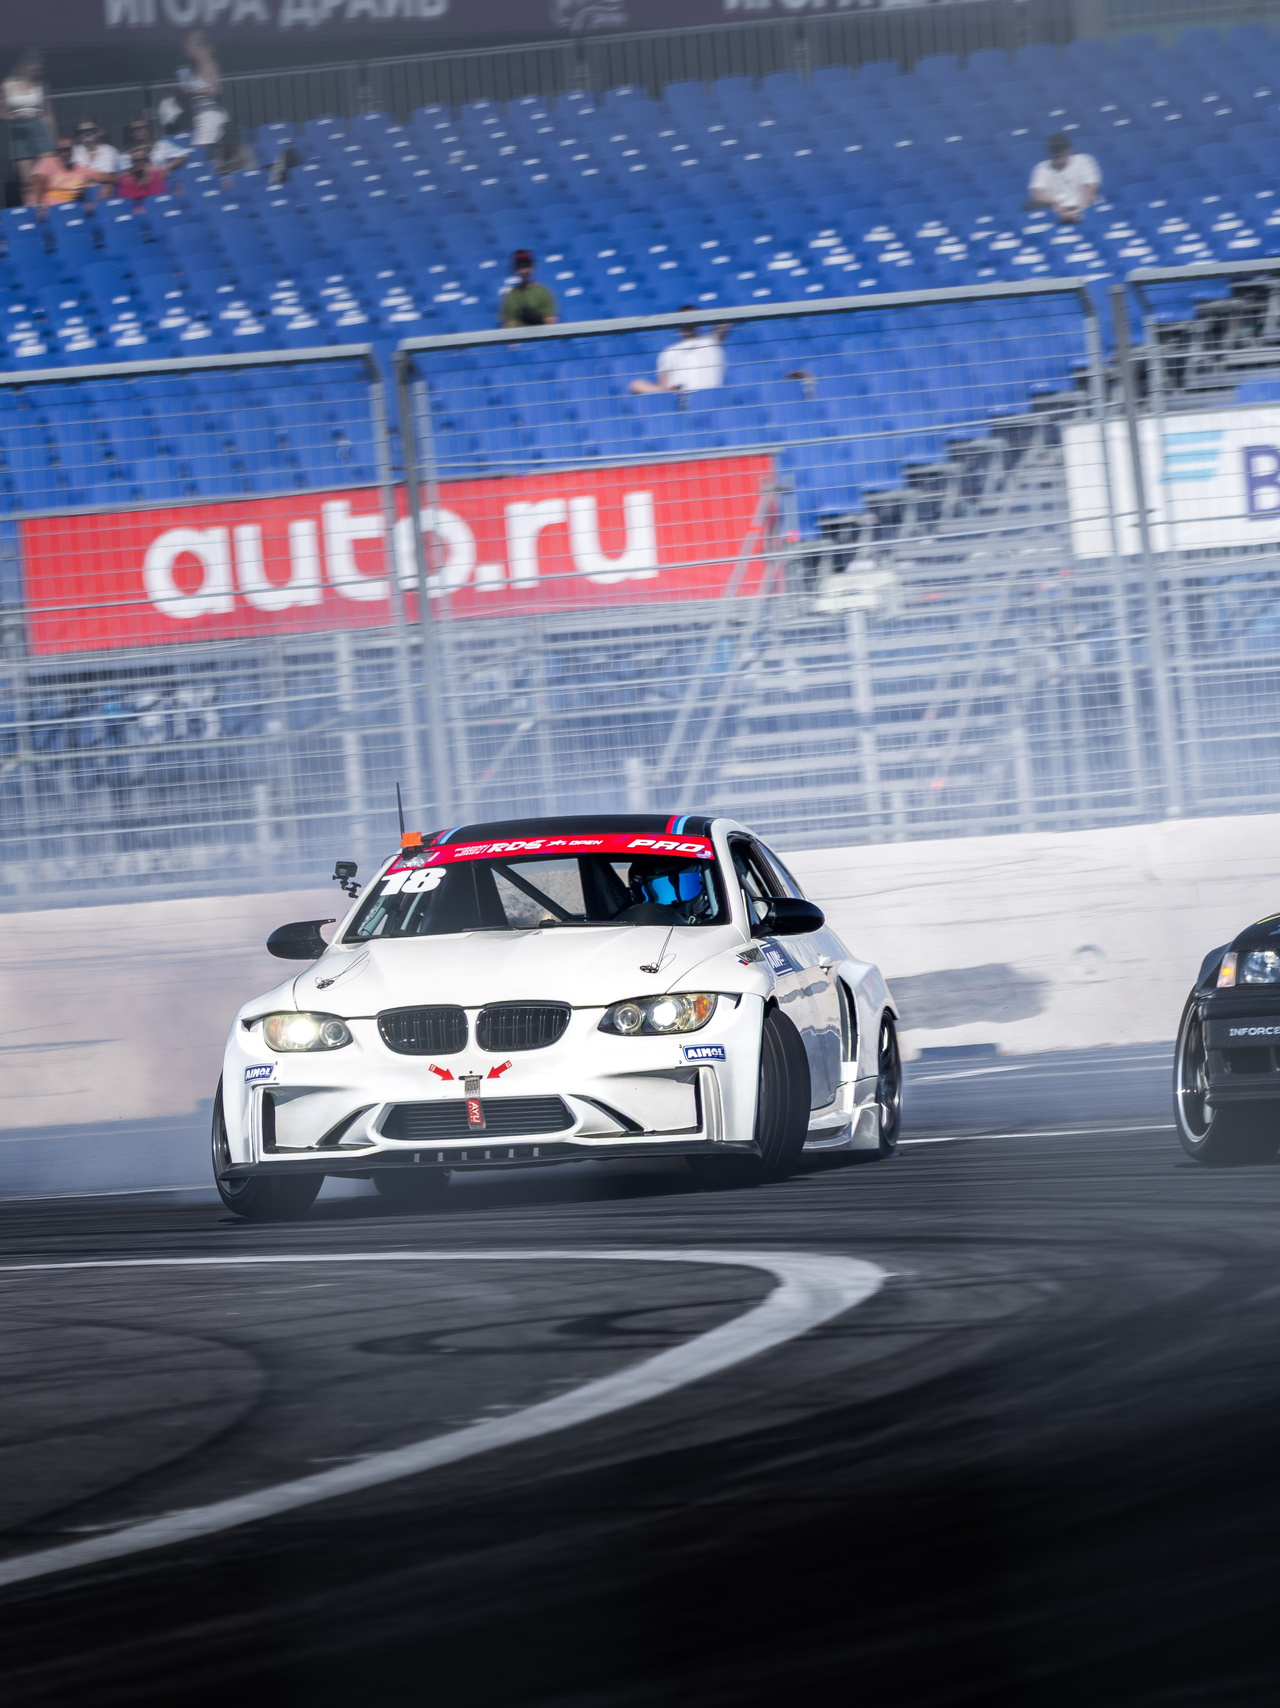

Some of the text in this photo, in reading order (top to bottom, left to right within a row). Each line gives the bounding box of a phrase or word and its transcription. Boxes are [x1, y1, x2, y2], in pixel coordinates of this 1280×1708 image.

[142, 491, 661, 620] auto.ru
[487, 839, 548, 853] RDS
[627, 838, 705, 853] PRO
[380, 867, 447, 896] 18
[687, 1047, 725, 1059] AIMOL
[246, 1067, 271, 1080] AIMOL
